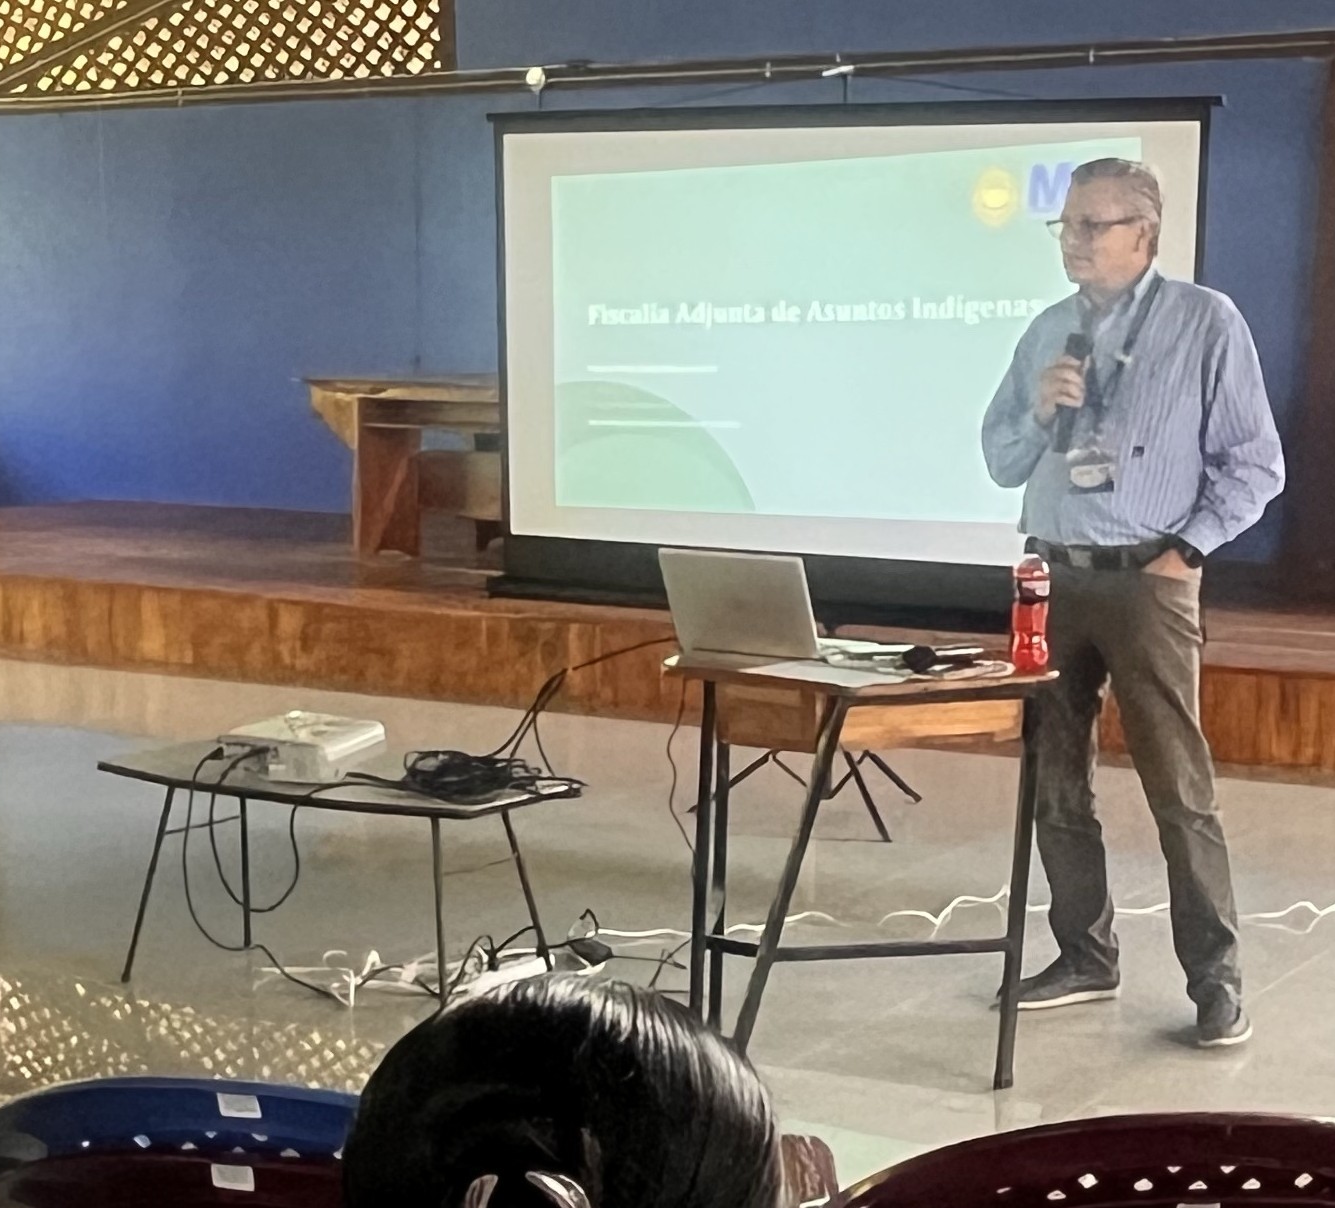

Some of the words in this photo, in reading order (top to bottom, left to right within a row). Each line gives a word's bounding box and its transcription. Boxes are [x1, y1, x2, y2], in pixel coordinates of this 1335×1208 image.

[675, 301, 766, 330] Adjunta
[771, 299, 802, 323] de
[807, 299, 906, 323] Asuntos
